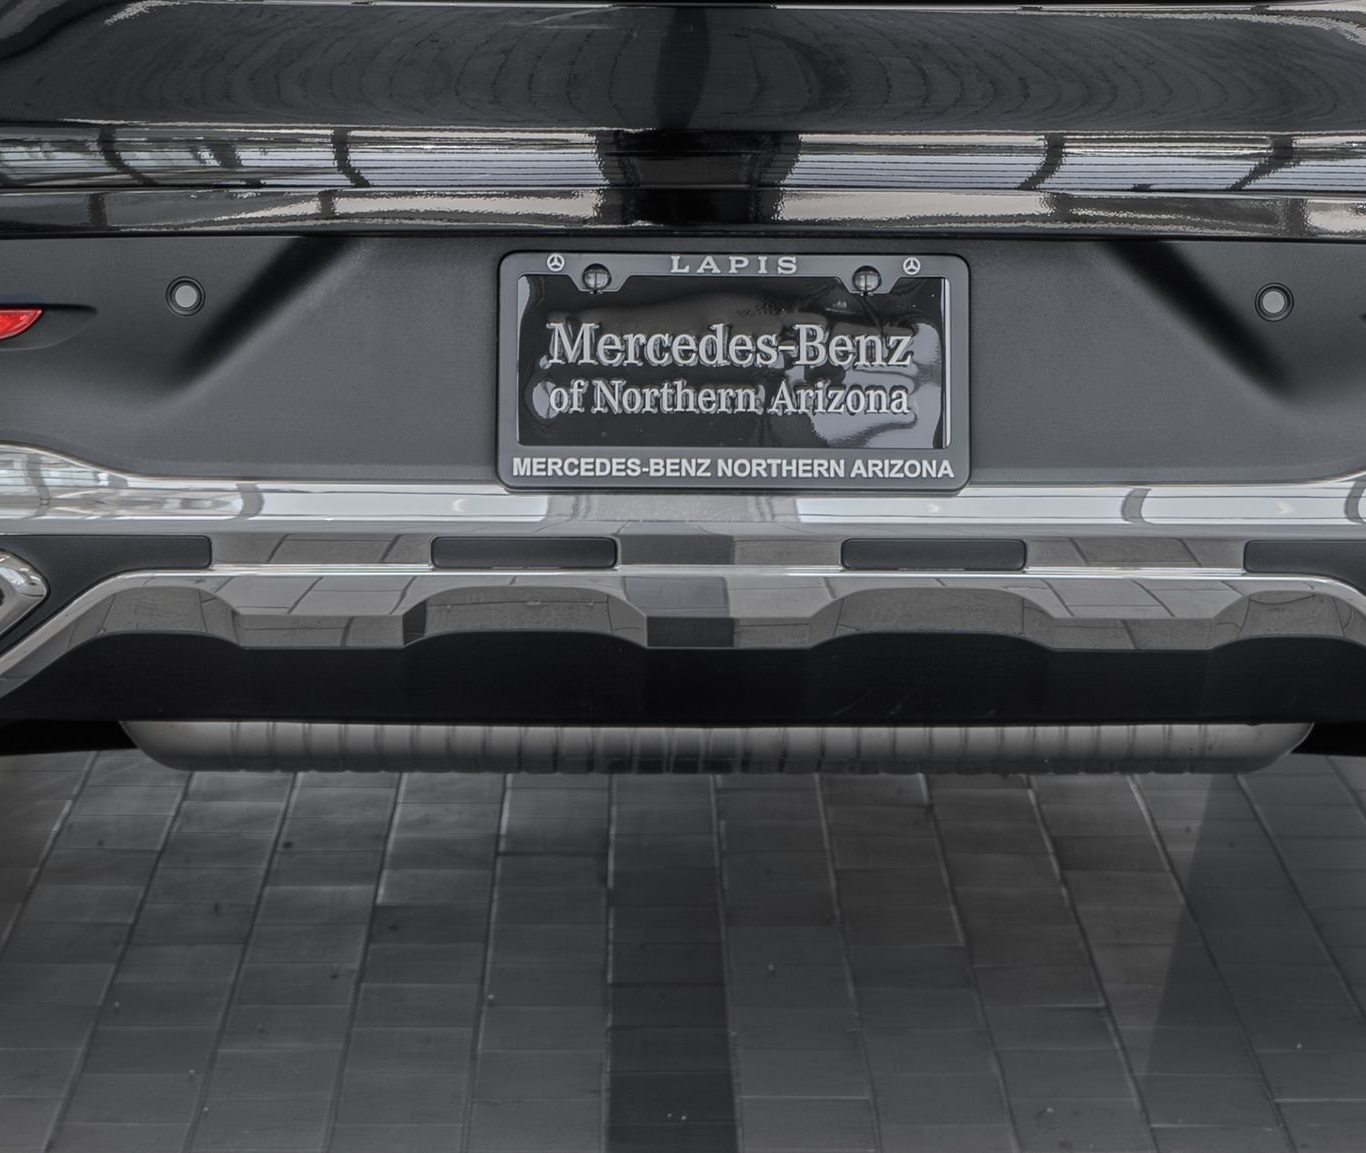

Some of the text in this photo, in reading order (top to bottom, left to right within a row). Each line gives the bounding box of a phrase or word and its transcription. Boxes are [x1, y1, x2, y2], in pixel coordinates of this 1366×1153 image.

[670, 255, 797, 275] LAPIS
[546, 322, 912, 367] Mercedes-Benz
[549, 379, 910, 415] of Northern Arizona
[512, 457, 955, 479] MERCEDES-BENZ NORTHERN ARIZONA
